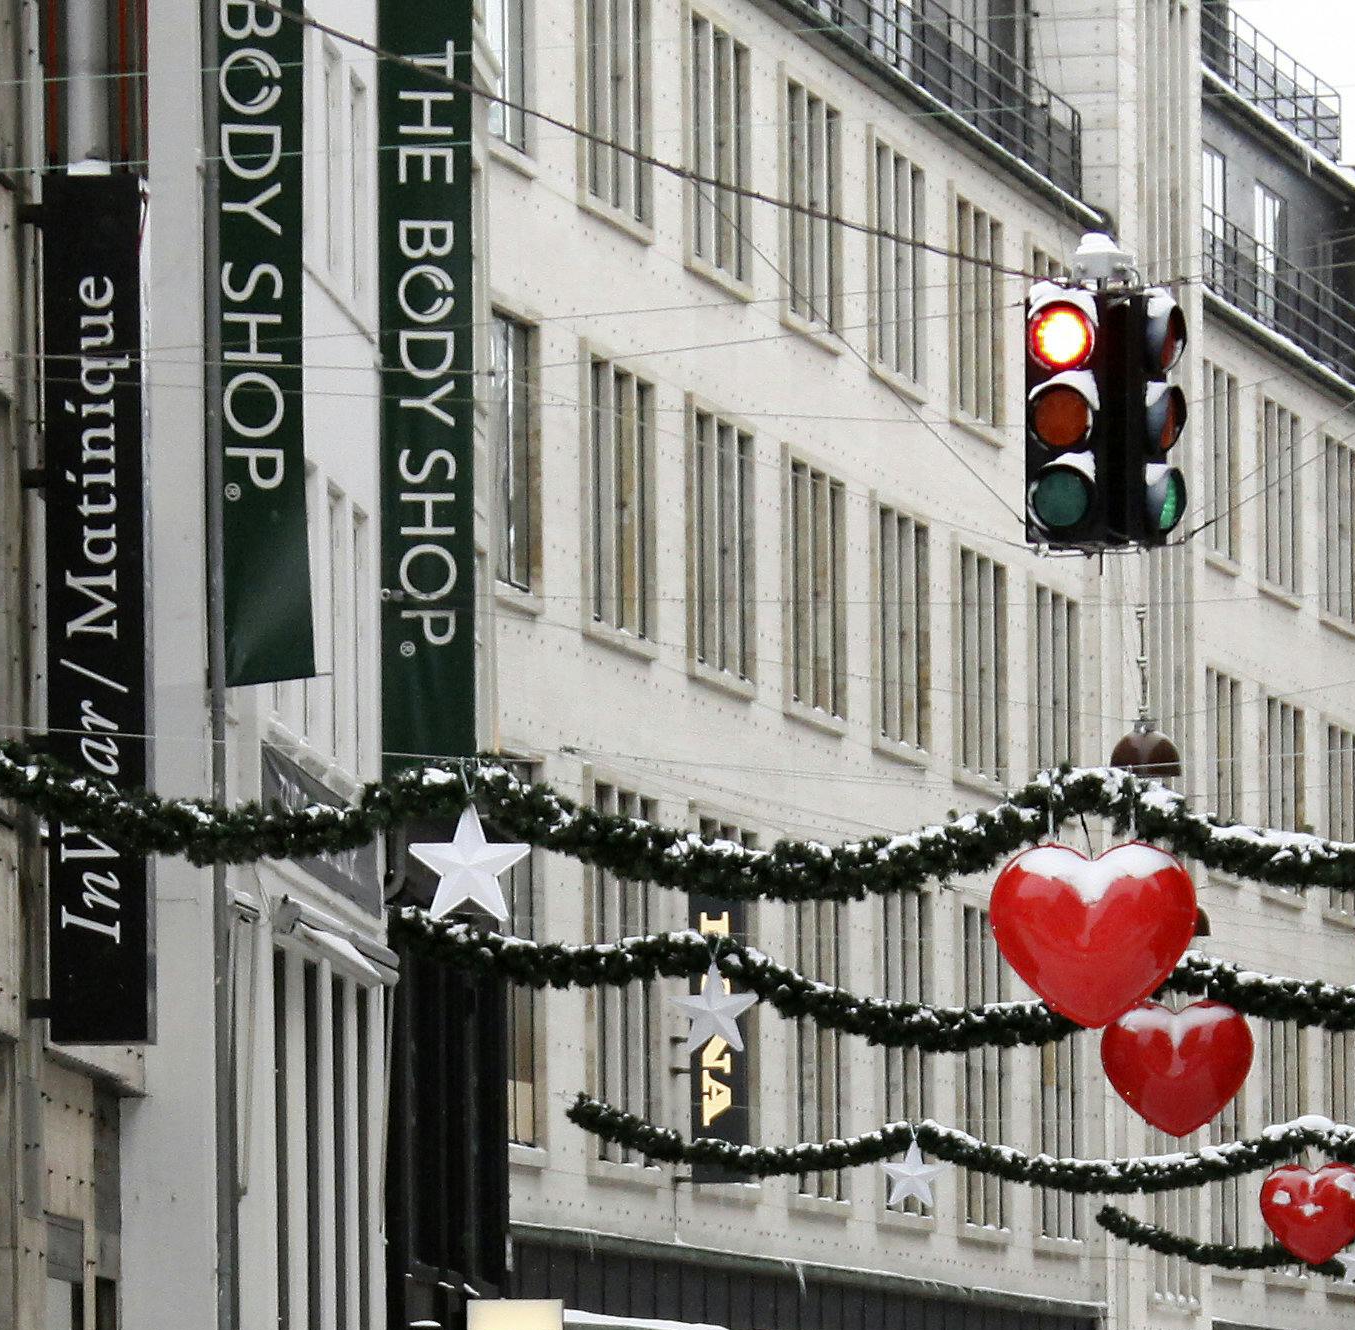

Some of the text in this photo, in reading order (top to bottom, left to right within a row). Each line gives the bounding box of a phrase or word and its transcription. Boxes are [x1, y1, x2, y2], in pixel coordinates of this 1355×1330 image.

[398, 40, 454, 185] THE
[398, 220, 455, 427] BODY
[64, 276, 130, 640] Matinique
[60, 700, 120, 944] InWar
